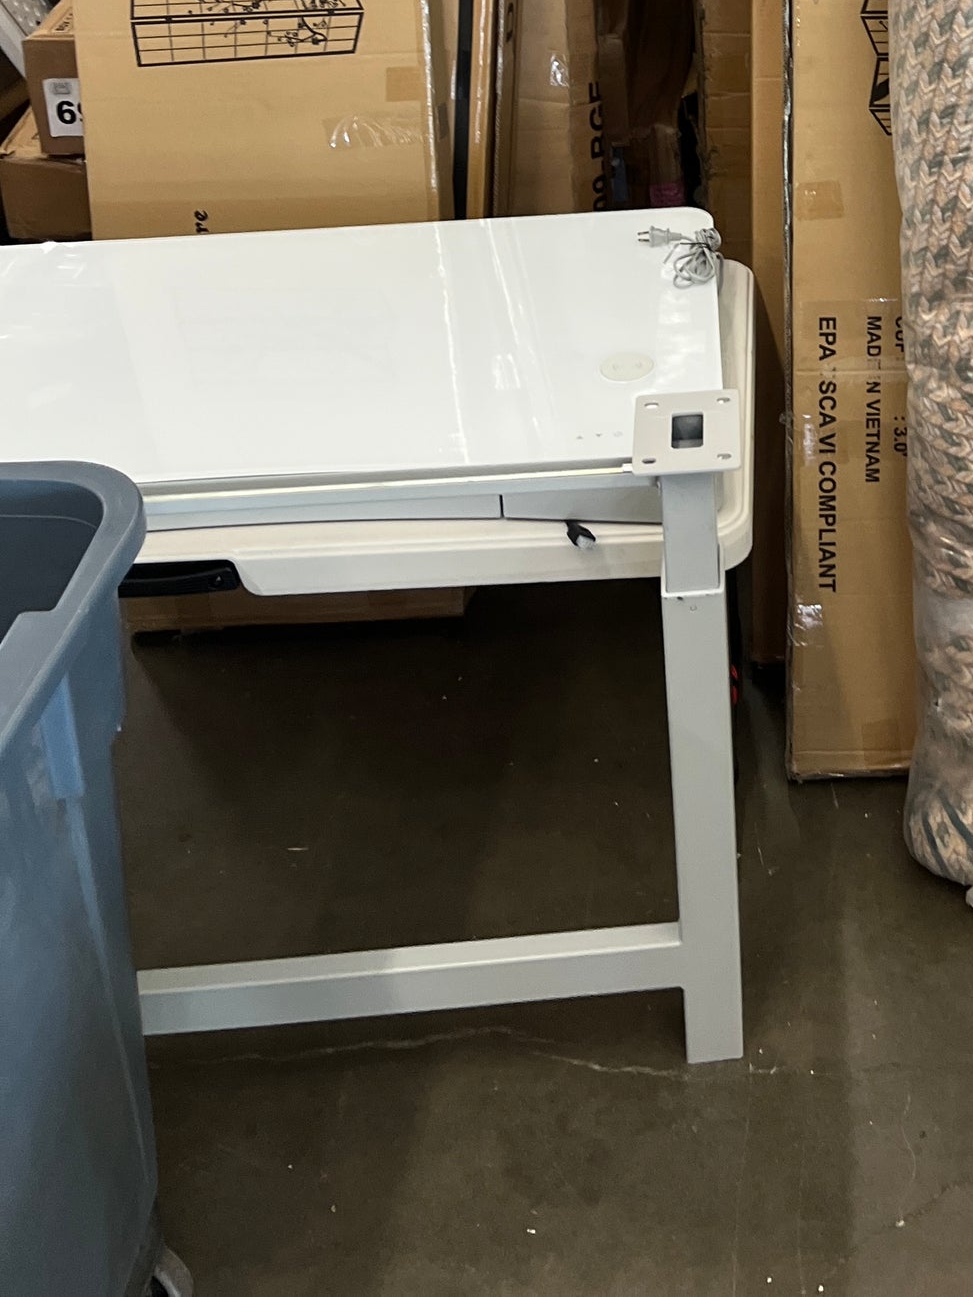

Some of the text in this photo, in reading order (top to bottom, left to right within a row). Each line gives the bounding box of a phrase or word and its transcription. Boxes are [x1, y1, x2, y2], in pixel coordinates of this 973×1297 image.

[56, 100, 83, 125] 6
[866, 316, 882, 370] MAD
[818, 316, 837, 592] EPA SCA VI COMPLIANT
[866, 399, 881, 483] VIETNAM
